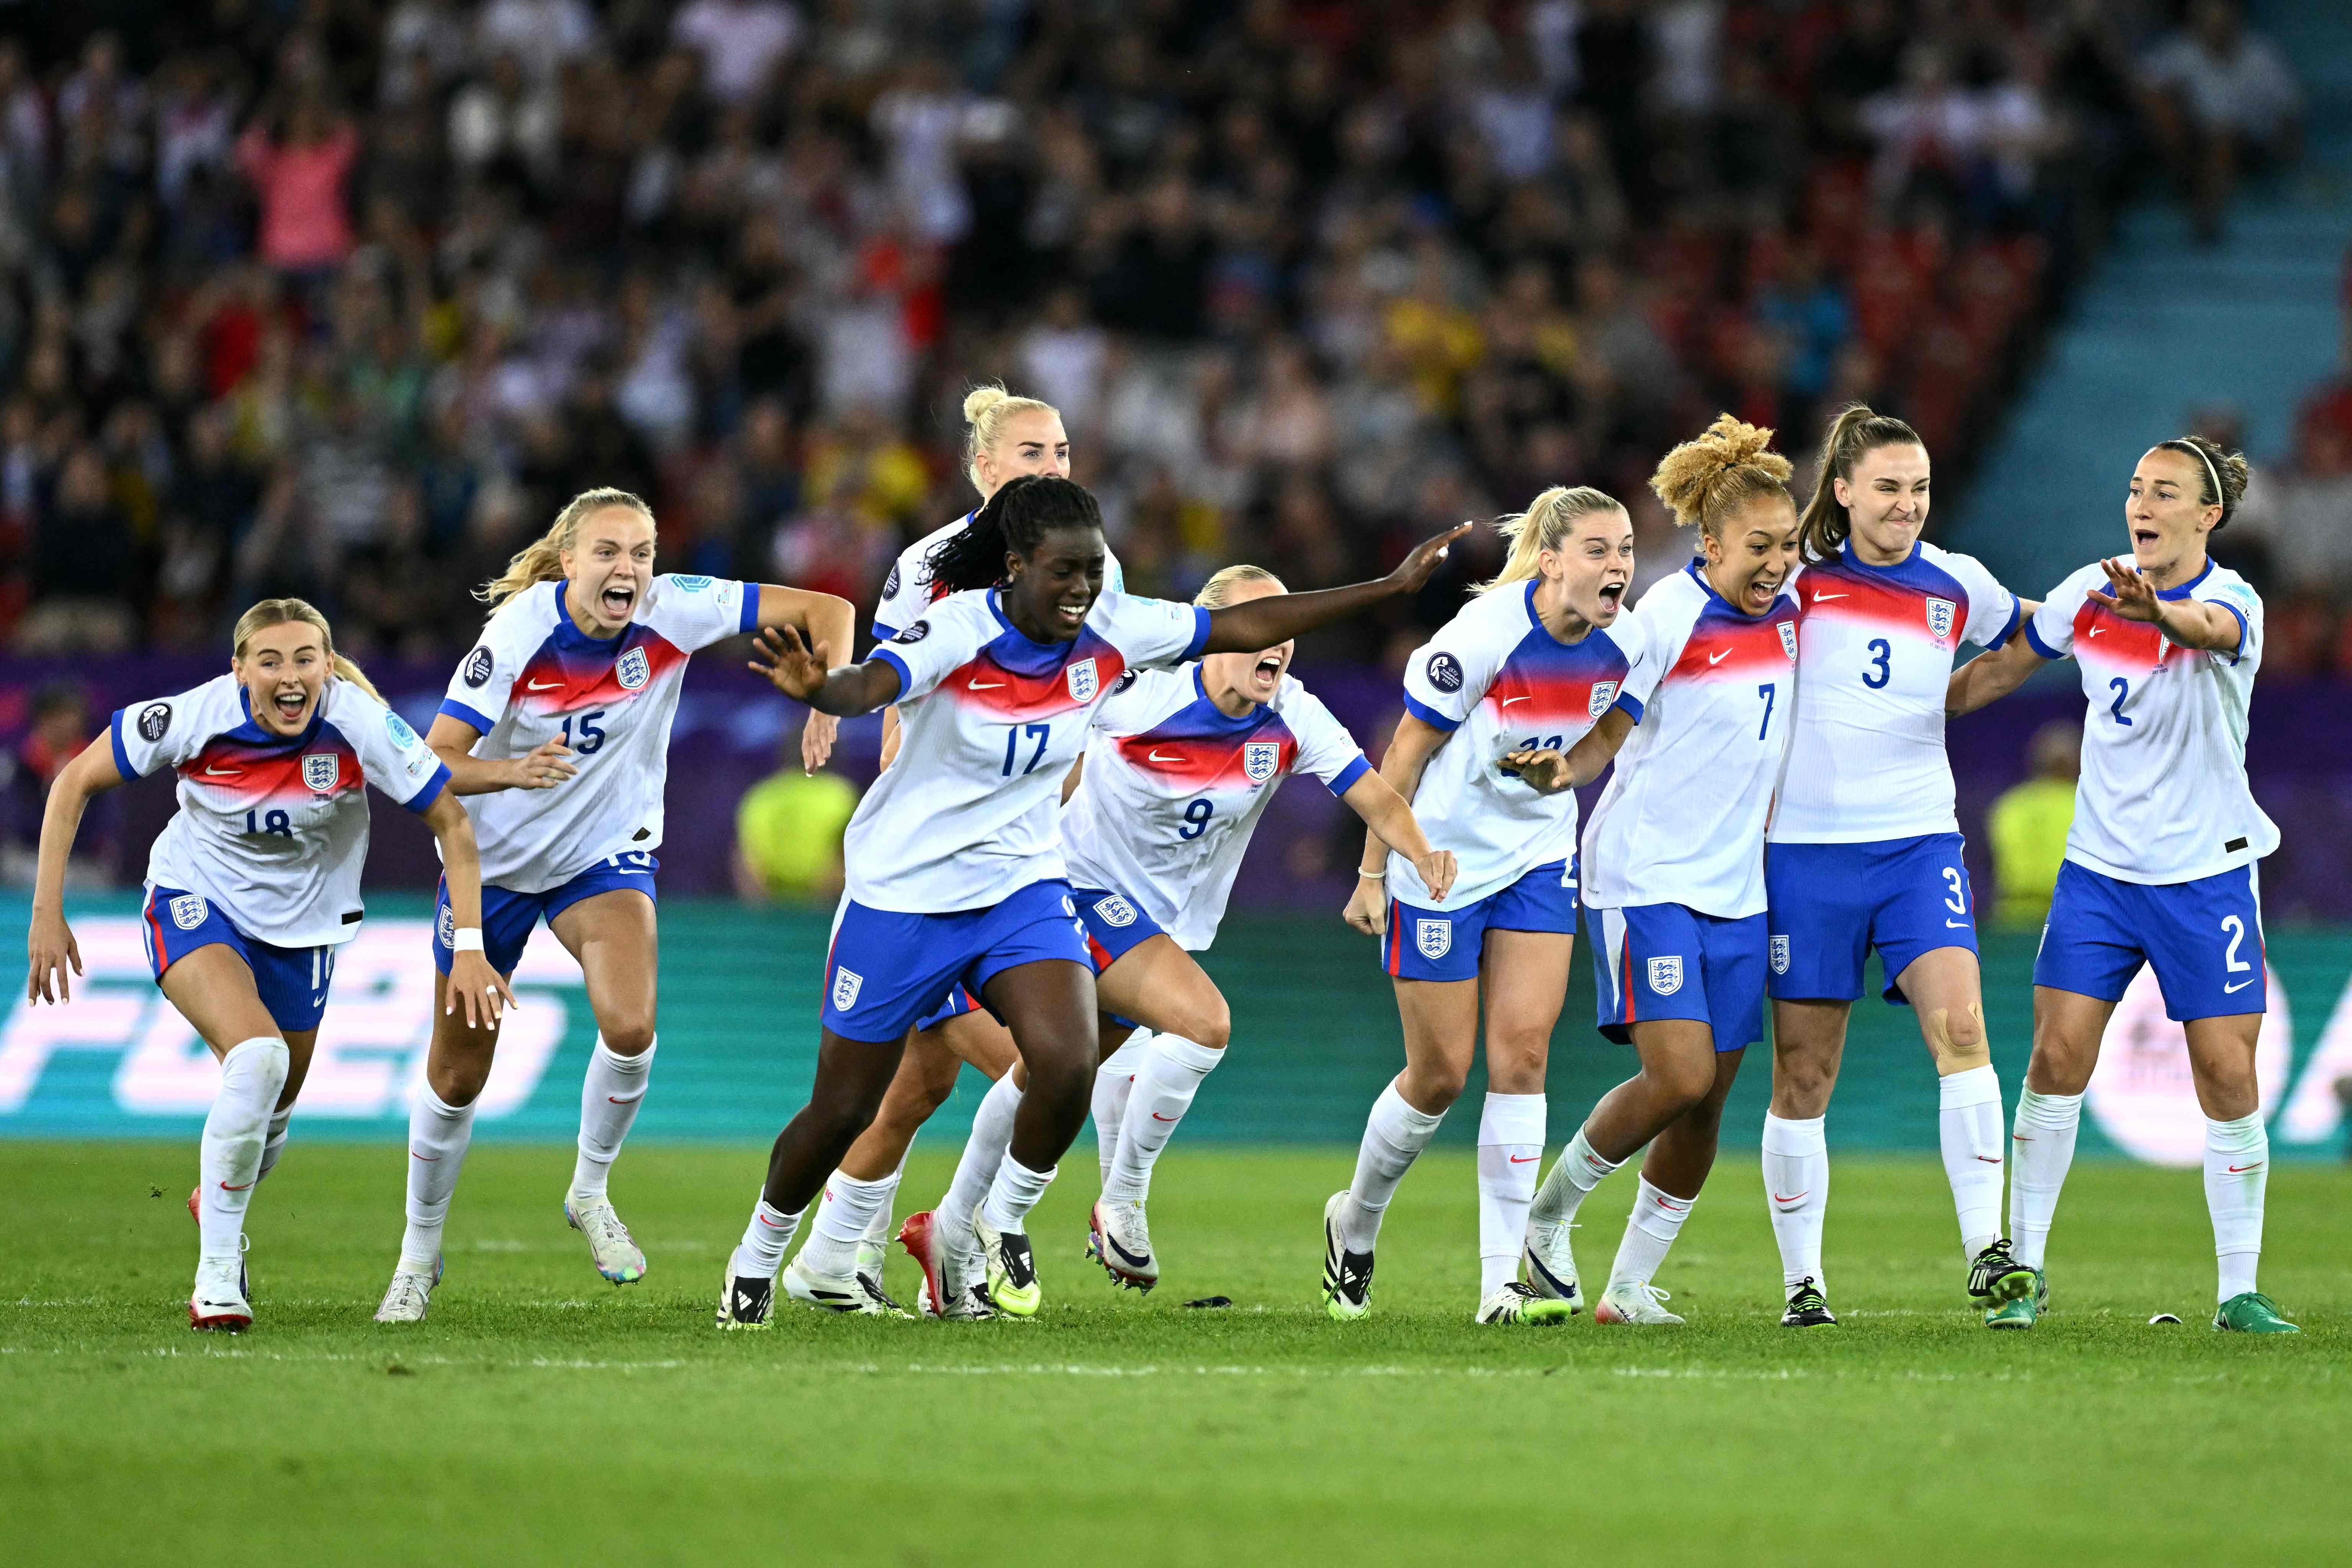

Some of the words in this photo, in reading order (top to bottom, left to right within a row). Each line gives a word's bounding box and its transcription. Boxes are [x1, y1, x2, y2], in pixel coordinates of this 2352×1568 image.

[475, 672, 484, 680] 2022
[1440, 671, 1459, 686] CHAMPIONS
[1442, 677, 1453, 687] 2022
[1443, 669, 1460, 682] EUROPEAN
[1862, 638, 1891, 689] 3
[1759, 683, 1775, 740] 7
[2110, 677, 2132, 726] 2
[562, 711, 605, 755] 15
[1002, 724, 1050, 776] 17
[247, 809, 292, 839] 18
[1179, 799, 1213, 840] 9
[1942, 867, 1966, 915] 3
[2221, 915, 2251, 973] 2
